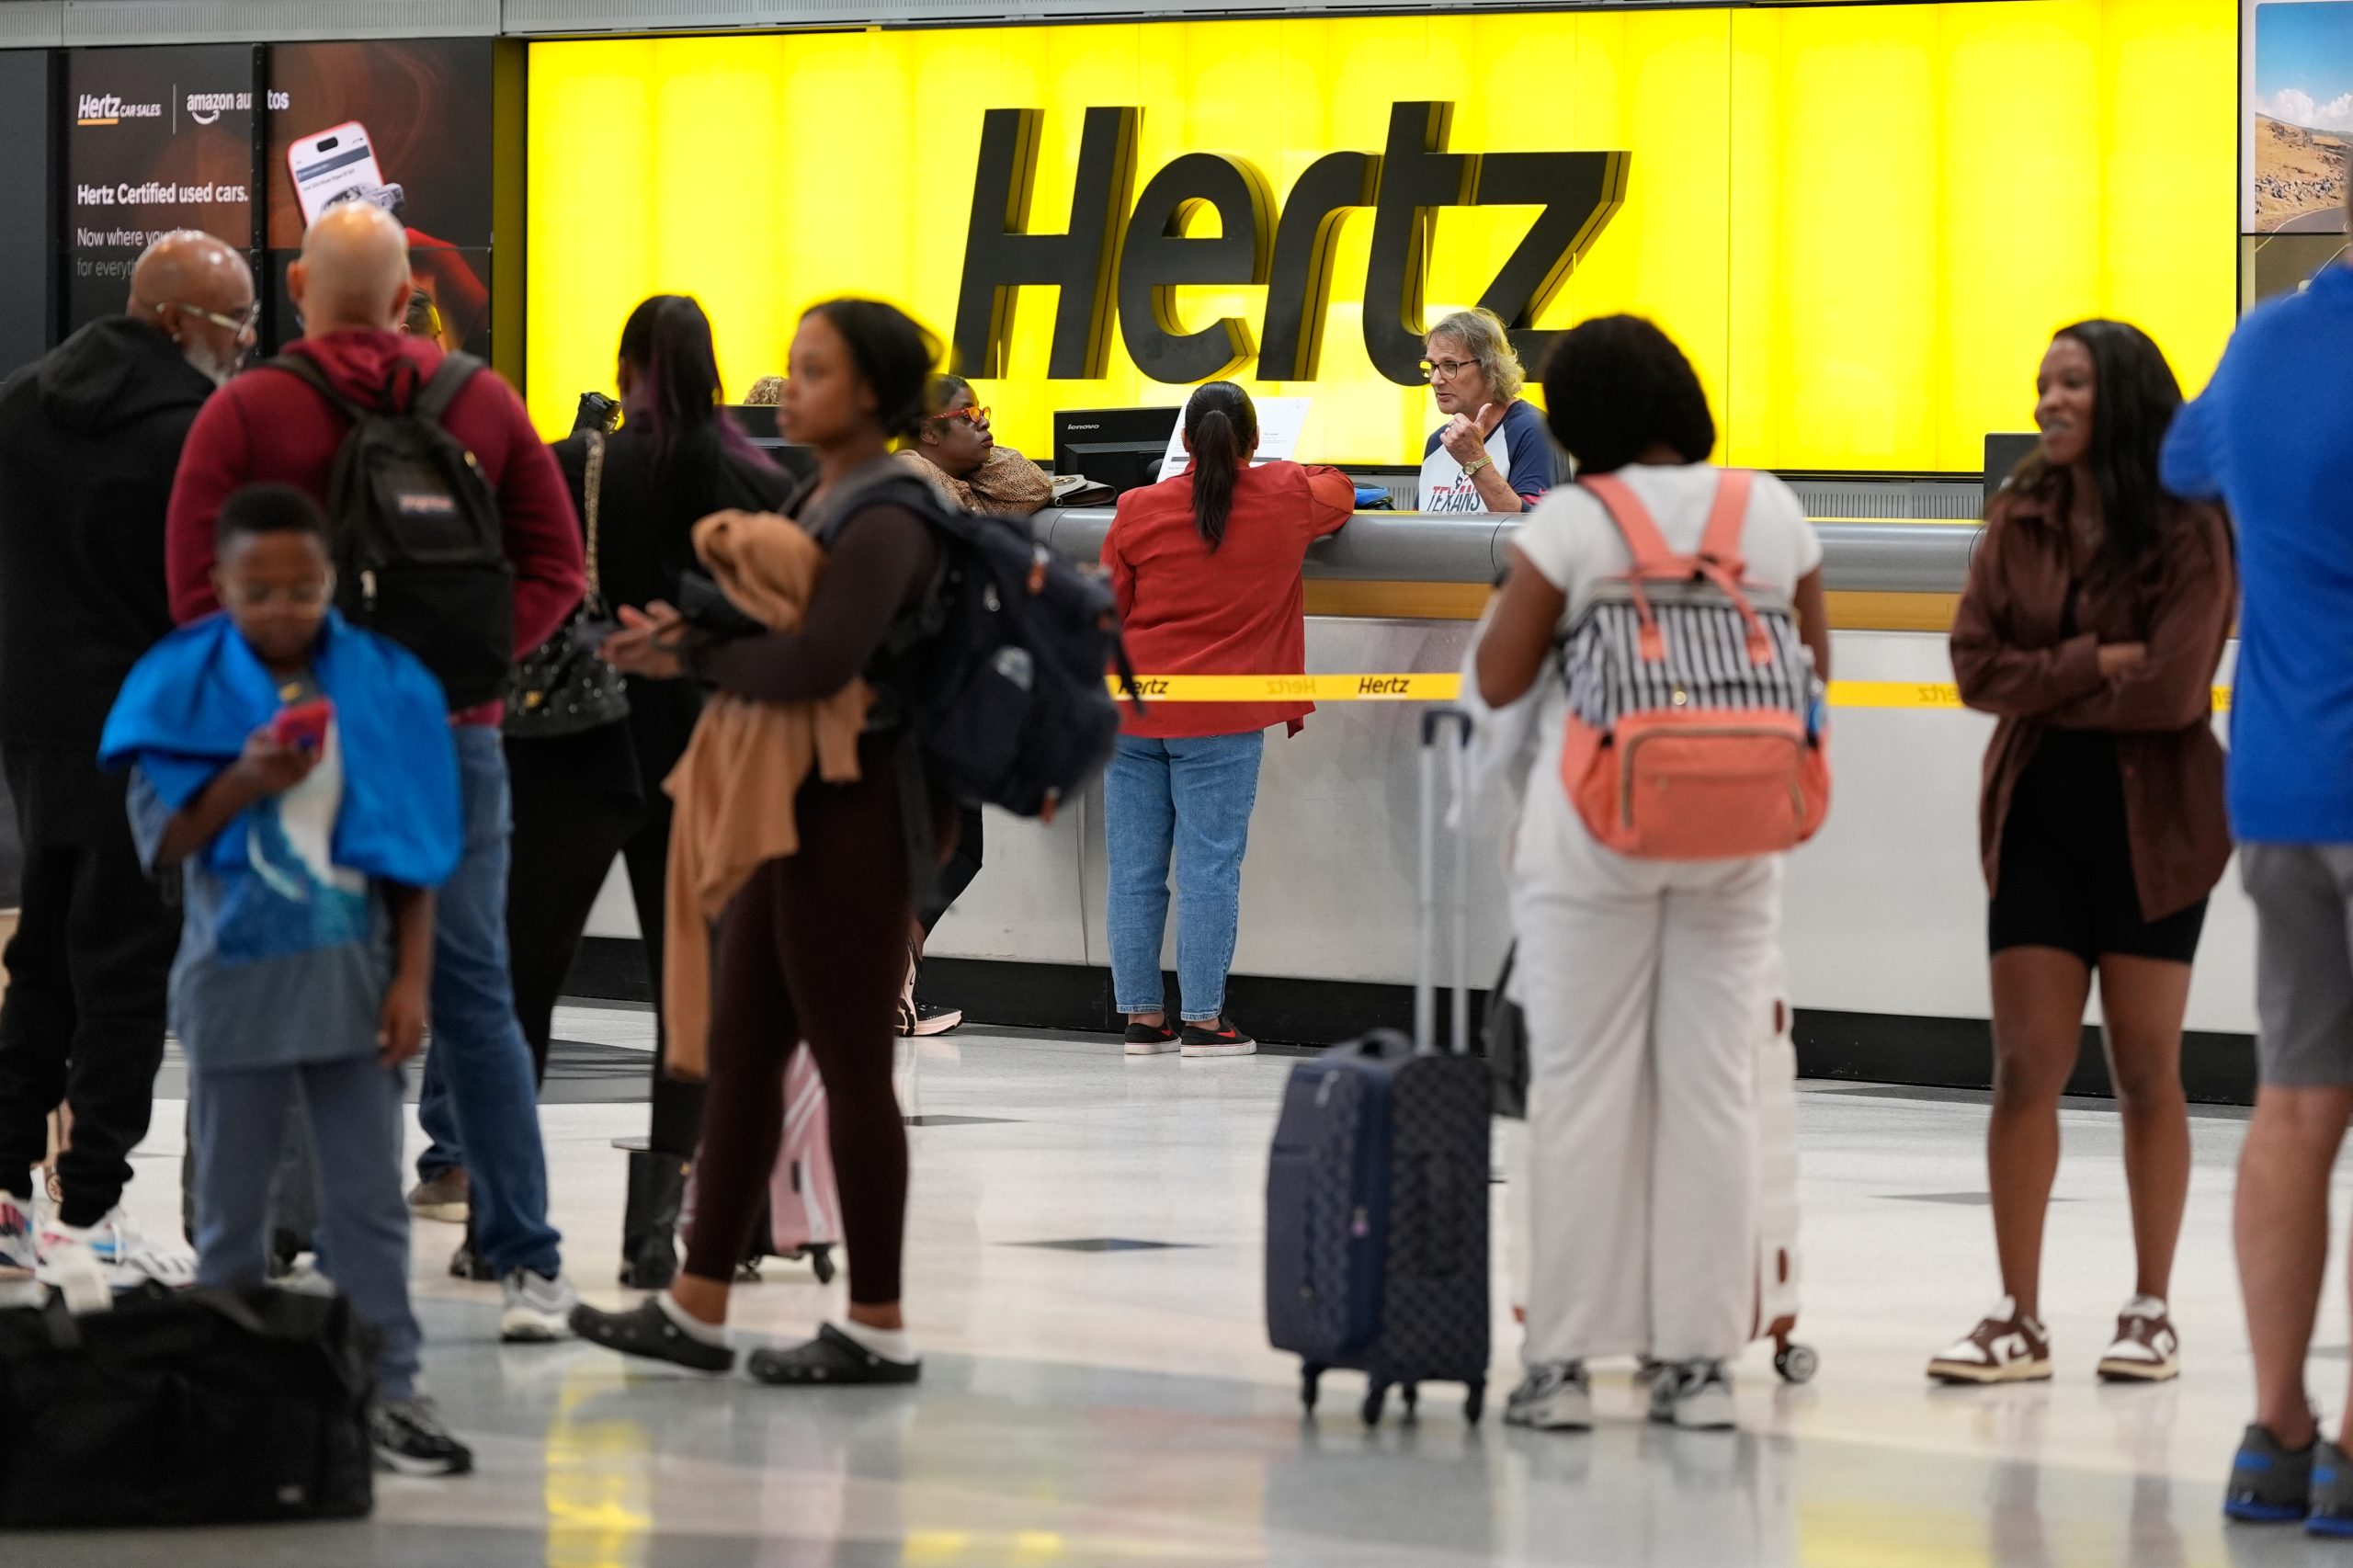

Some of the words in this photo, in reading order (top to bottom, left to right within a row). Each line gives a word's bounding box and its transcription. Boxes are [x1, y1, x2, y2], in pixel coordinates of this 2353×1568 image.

[78, 93, 121, 119] Hertz
[119, 104, 136, 118] CAR
[135, 103, 162, 117] SALES
[187, 93, 234, 111] amazon
[77, 184, 114, 205] Hertz
[117, 182, 176, 204] Certified
[179, 182, 212, 203] used
[216, 185, 249, 203] cars.
[77, 226, 104, 247] Now
[107, 226, 143, 247] where
[949, 100, 1632, 385] Hertz
[76, 256, 94, 278] for
[1427, 485, 1480, 511] TEXANS
[1358, 677, 1410, 694] Hertz
